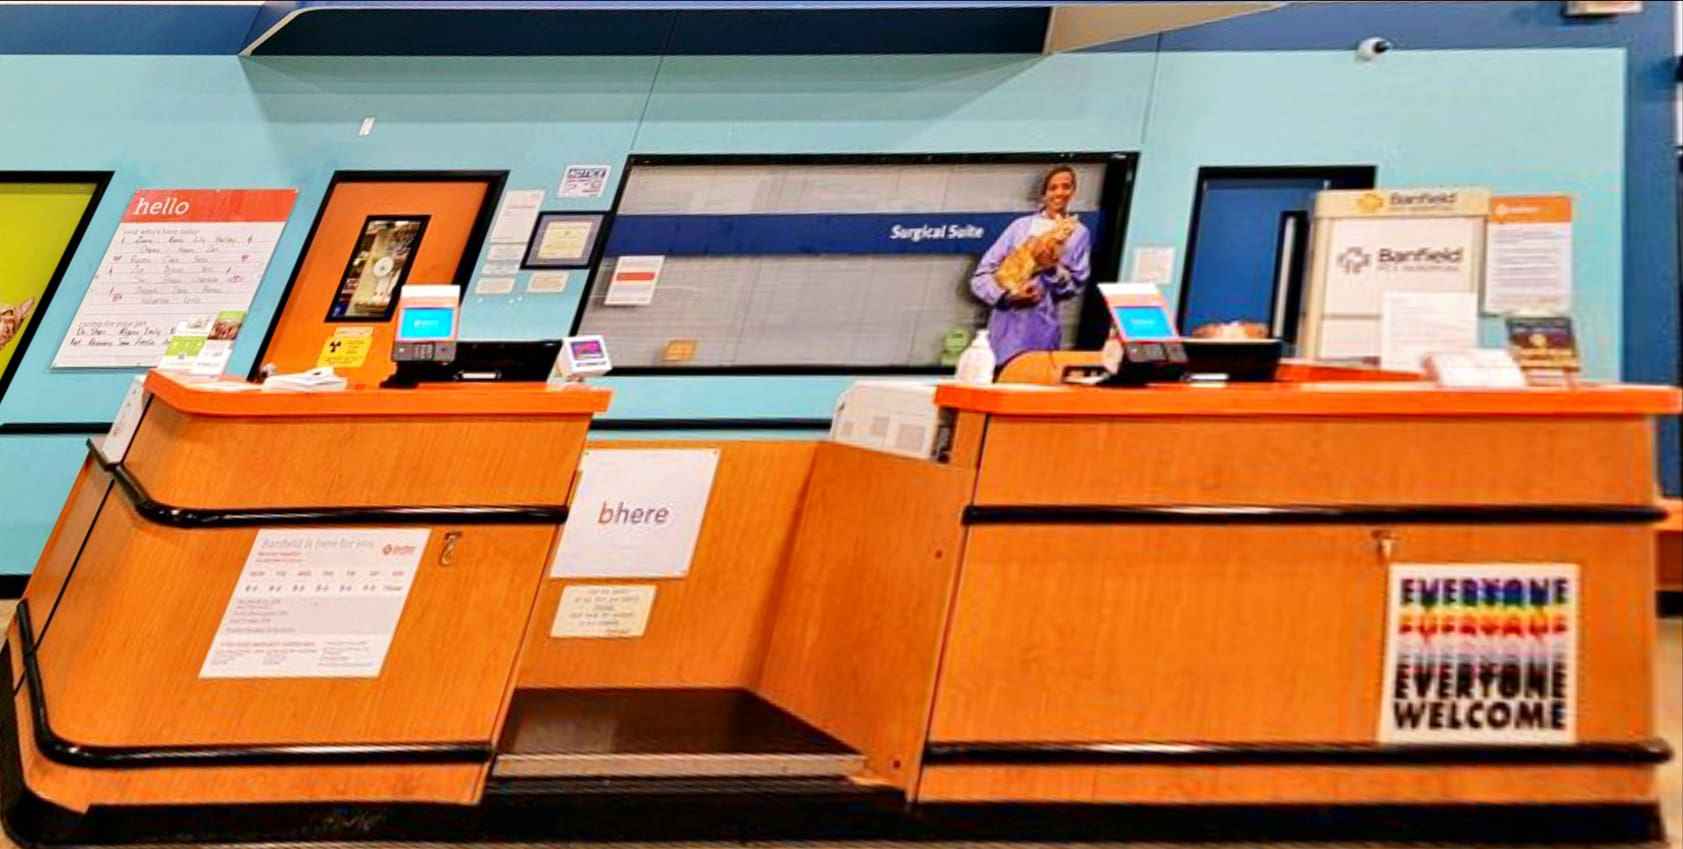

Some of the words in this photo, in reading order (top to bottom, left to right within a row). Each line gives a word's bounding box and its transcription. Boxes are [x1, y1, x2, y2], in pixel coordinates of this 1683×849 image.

[133, 197, 190, 215] hello
[1388, 191, 1458, 205] Banfield
[890, 224, 947, 242] Surgical
[948, 225, 984, 239] Suite
[1378, 247, 1463, 262] Banfield
[597, 501, 670, 525] bhere
[1400, 578, 1568, 606] EVERYONE
[1395, 657, 1567, 699] EVERYONE
[1393, 701, 1566, 730] WELCOME
